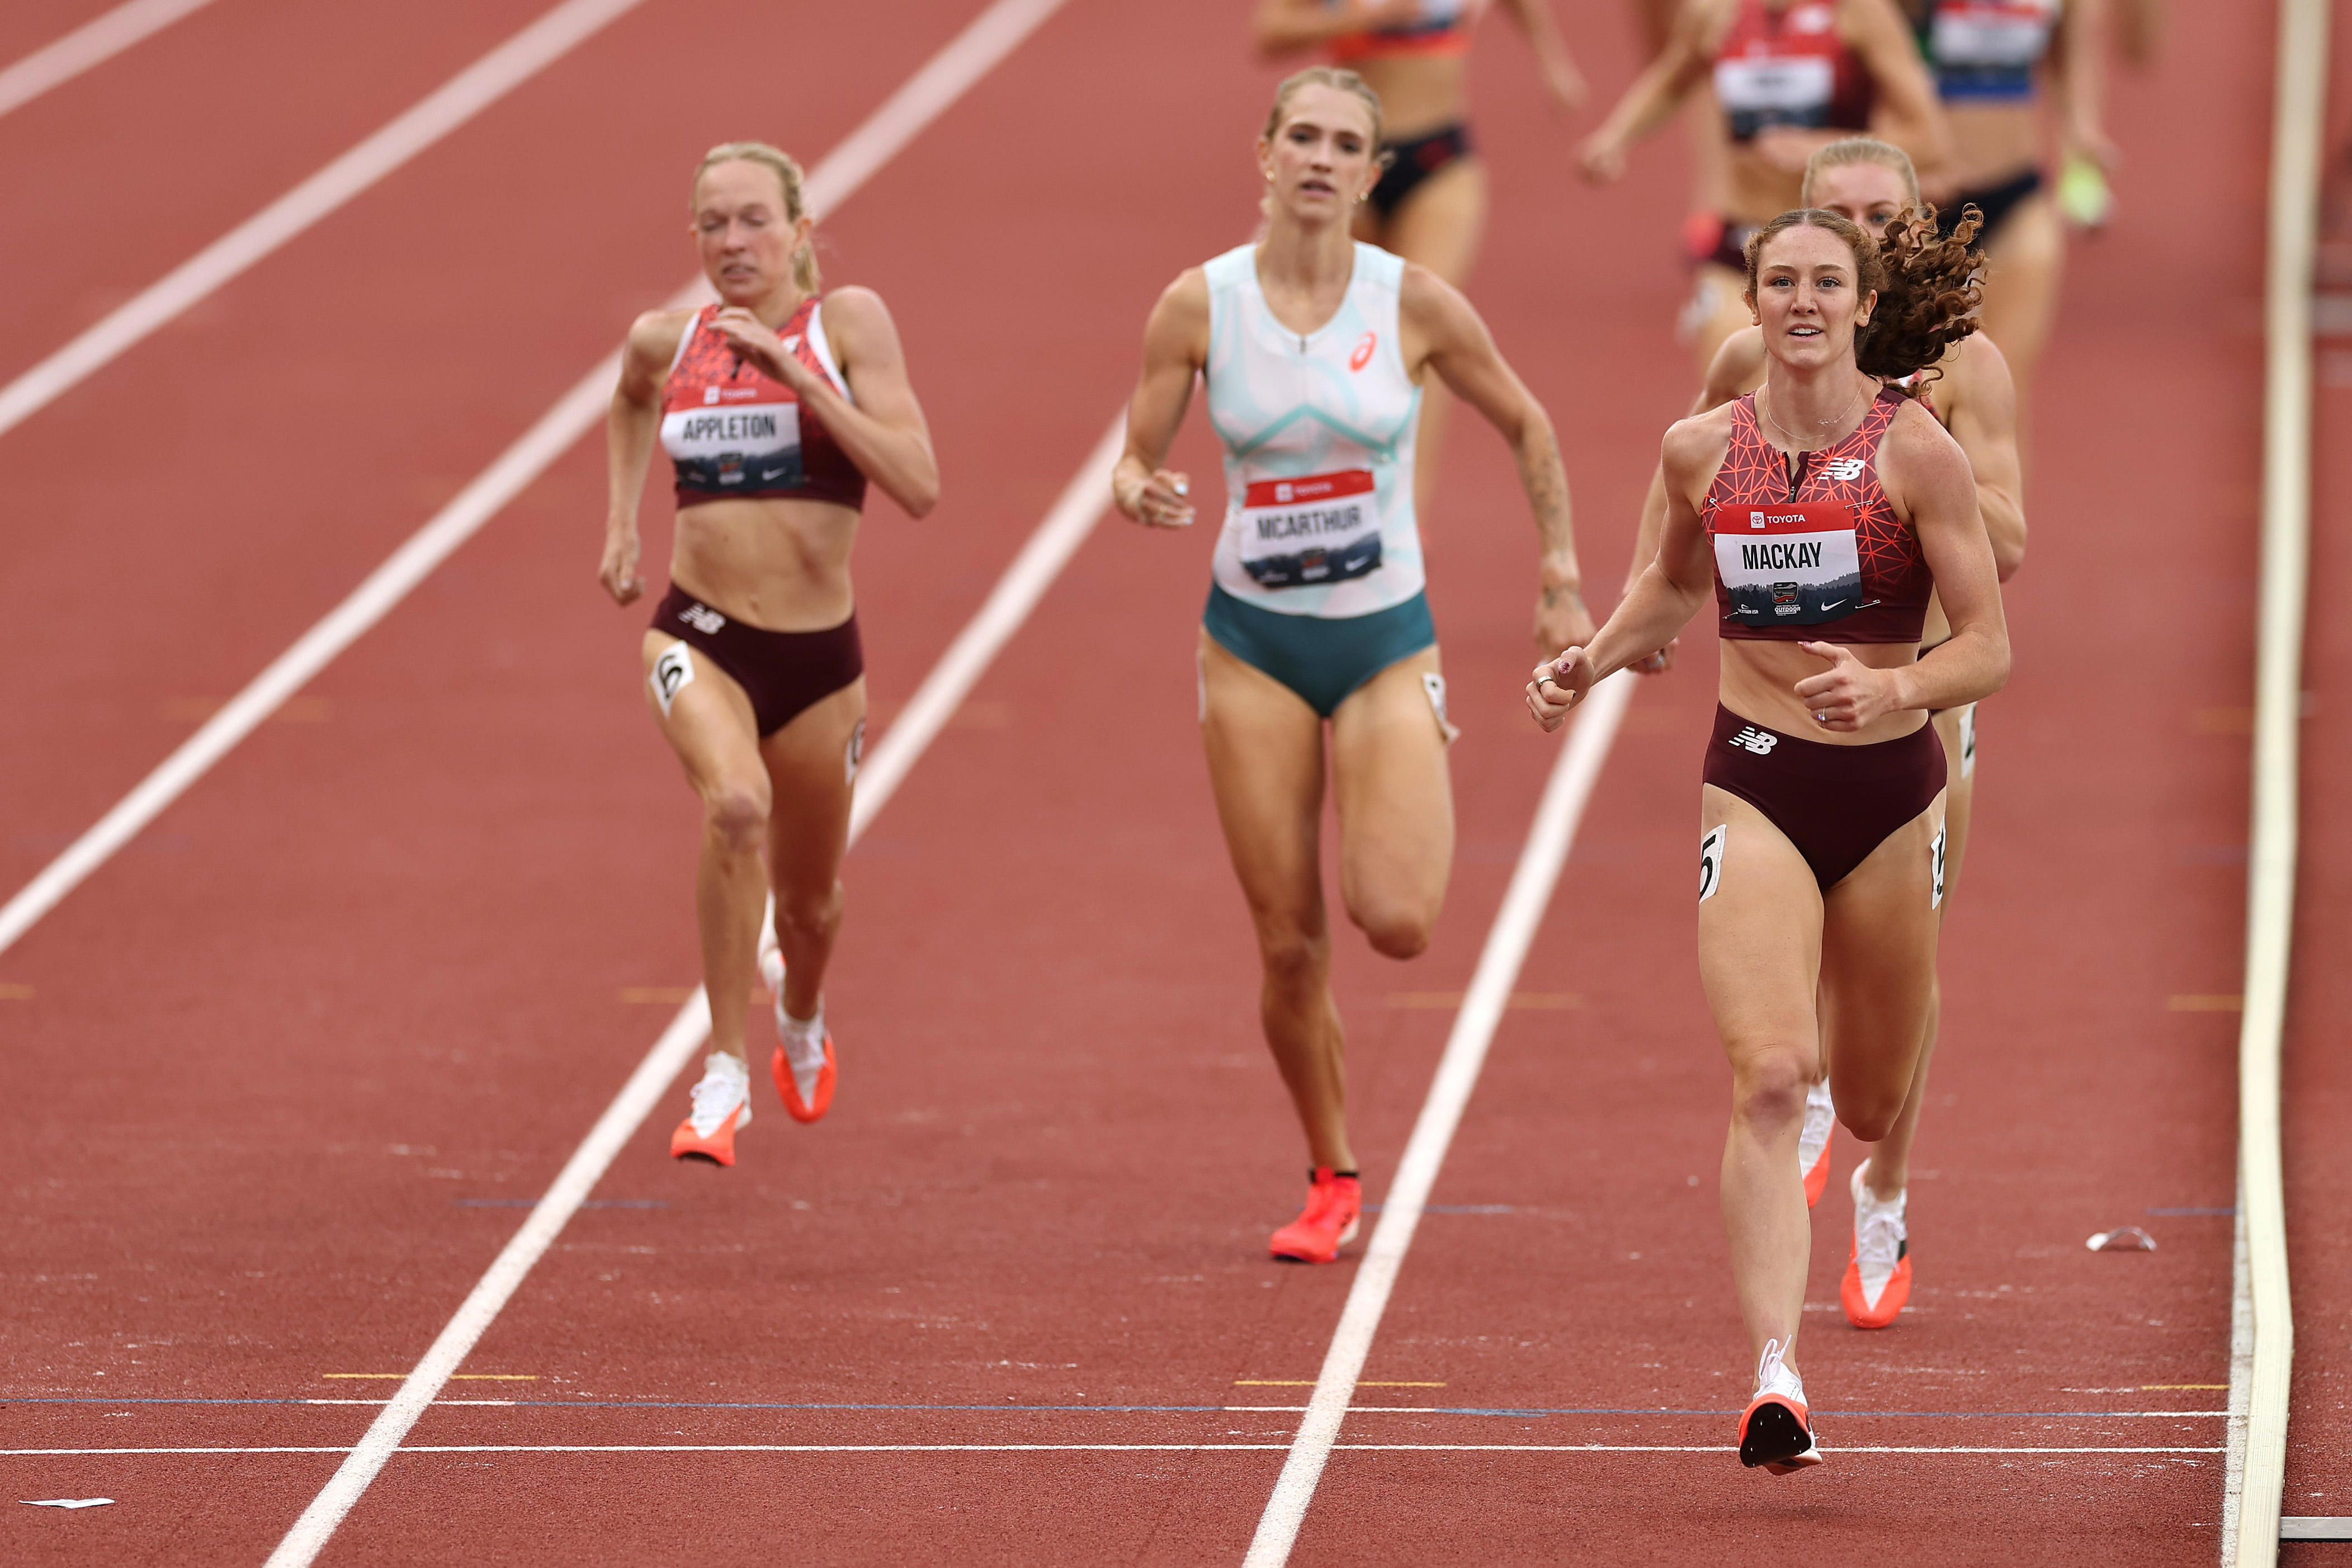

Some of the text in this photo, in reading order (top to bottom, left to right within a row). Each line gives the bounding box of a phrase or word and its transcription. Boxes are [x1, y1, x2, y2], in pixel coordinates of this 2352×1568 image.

[683, 414, 776, 441] APPLETON
[1817, 457, 1866, 481] NB
[1257, 506, 1361, 540] MCARTHUR
[1767, 514, 1806, 524] TOYOTA
[1742, 542, 1822, 570] MACKAY
[658, 654, 683, 700] 6
[1728, 726, 1778, 755] NB
